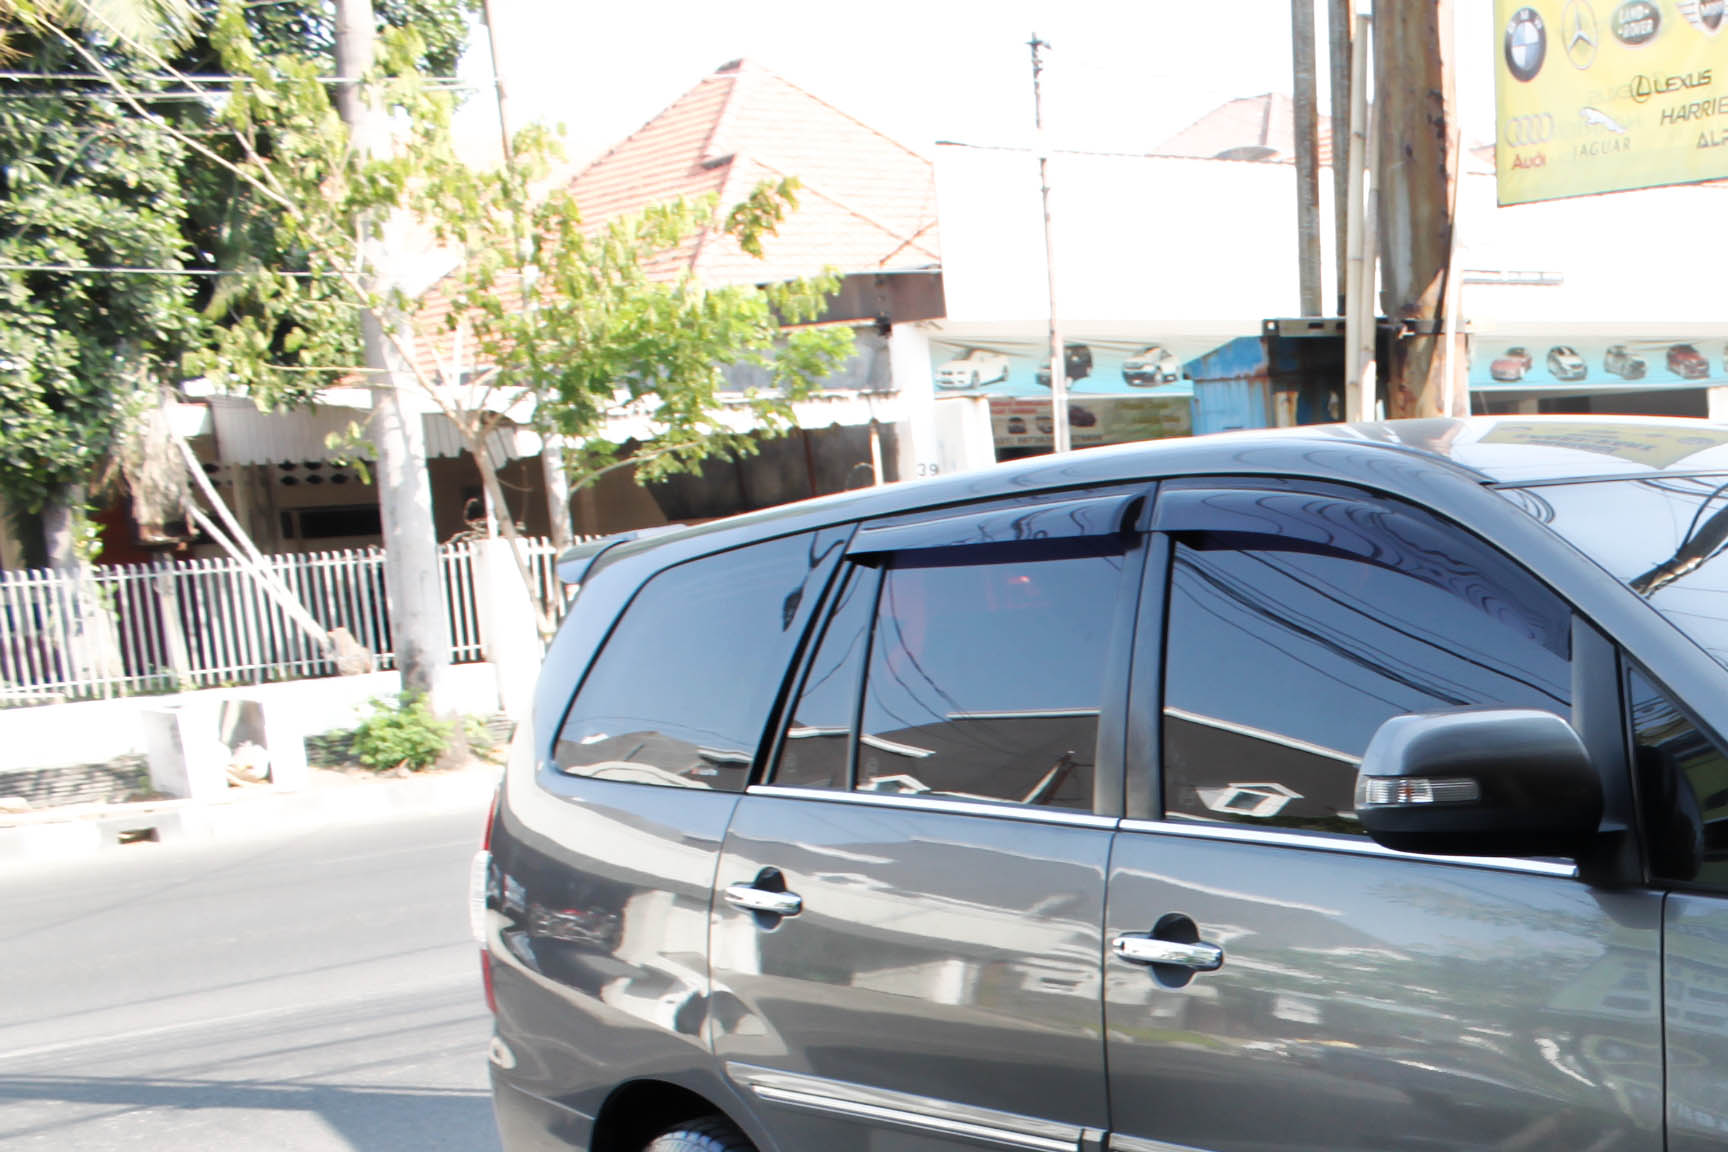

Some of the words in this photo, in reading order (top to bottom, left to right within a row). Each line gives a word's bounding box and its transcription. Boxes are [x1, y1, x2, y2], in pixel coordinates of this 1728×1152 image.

[1653, 69, 1712, 94] LEXUS
[1572, 136, 1631, 161] JAGUAR
[1511, 153, 1546, 170] Audi
[917, 463, 938, 477] 39
